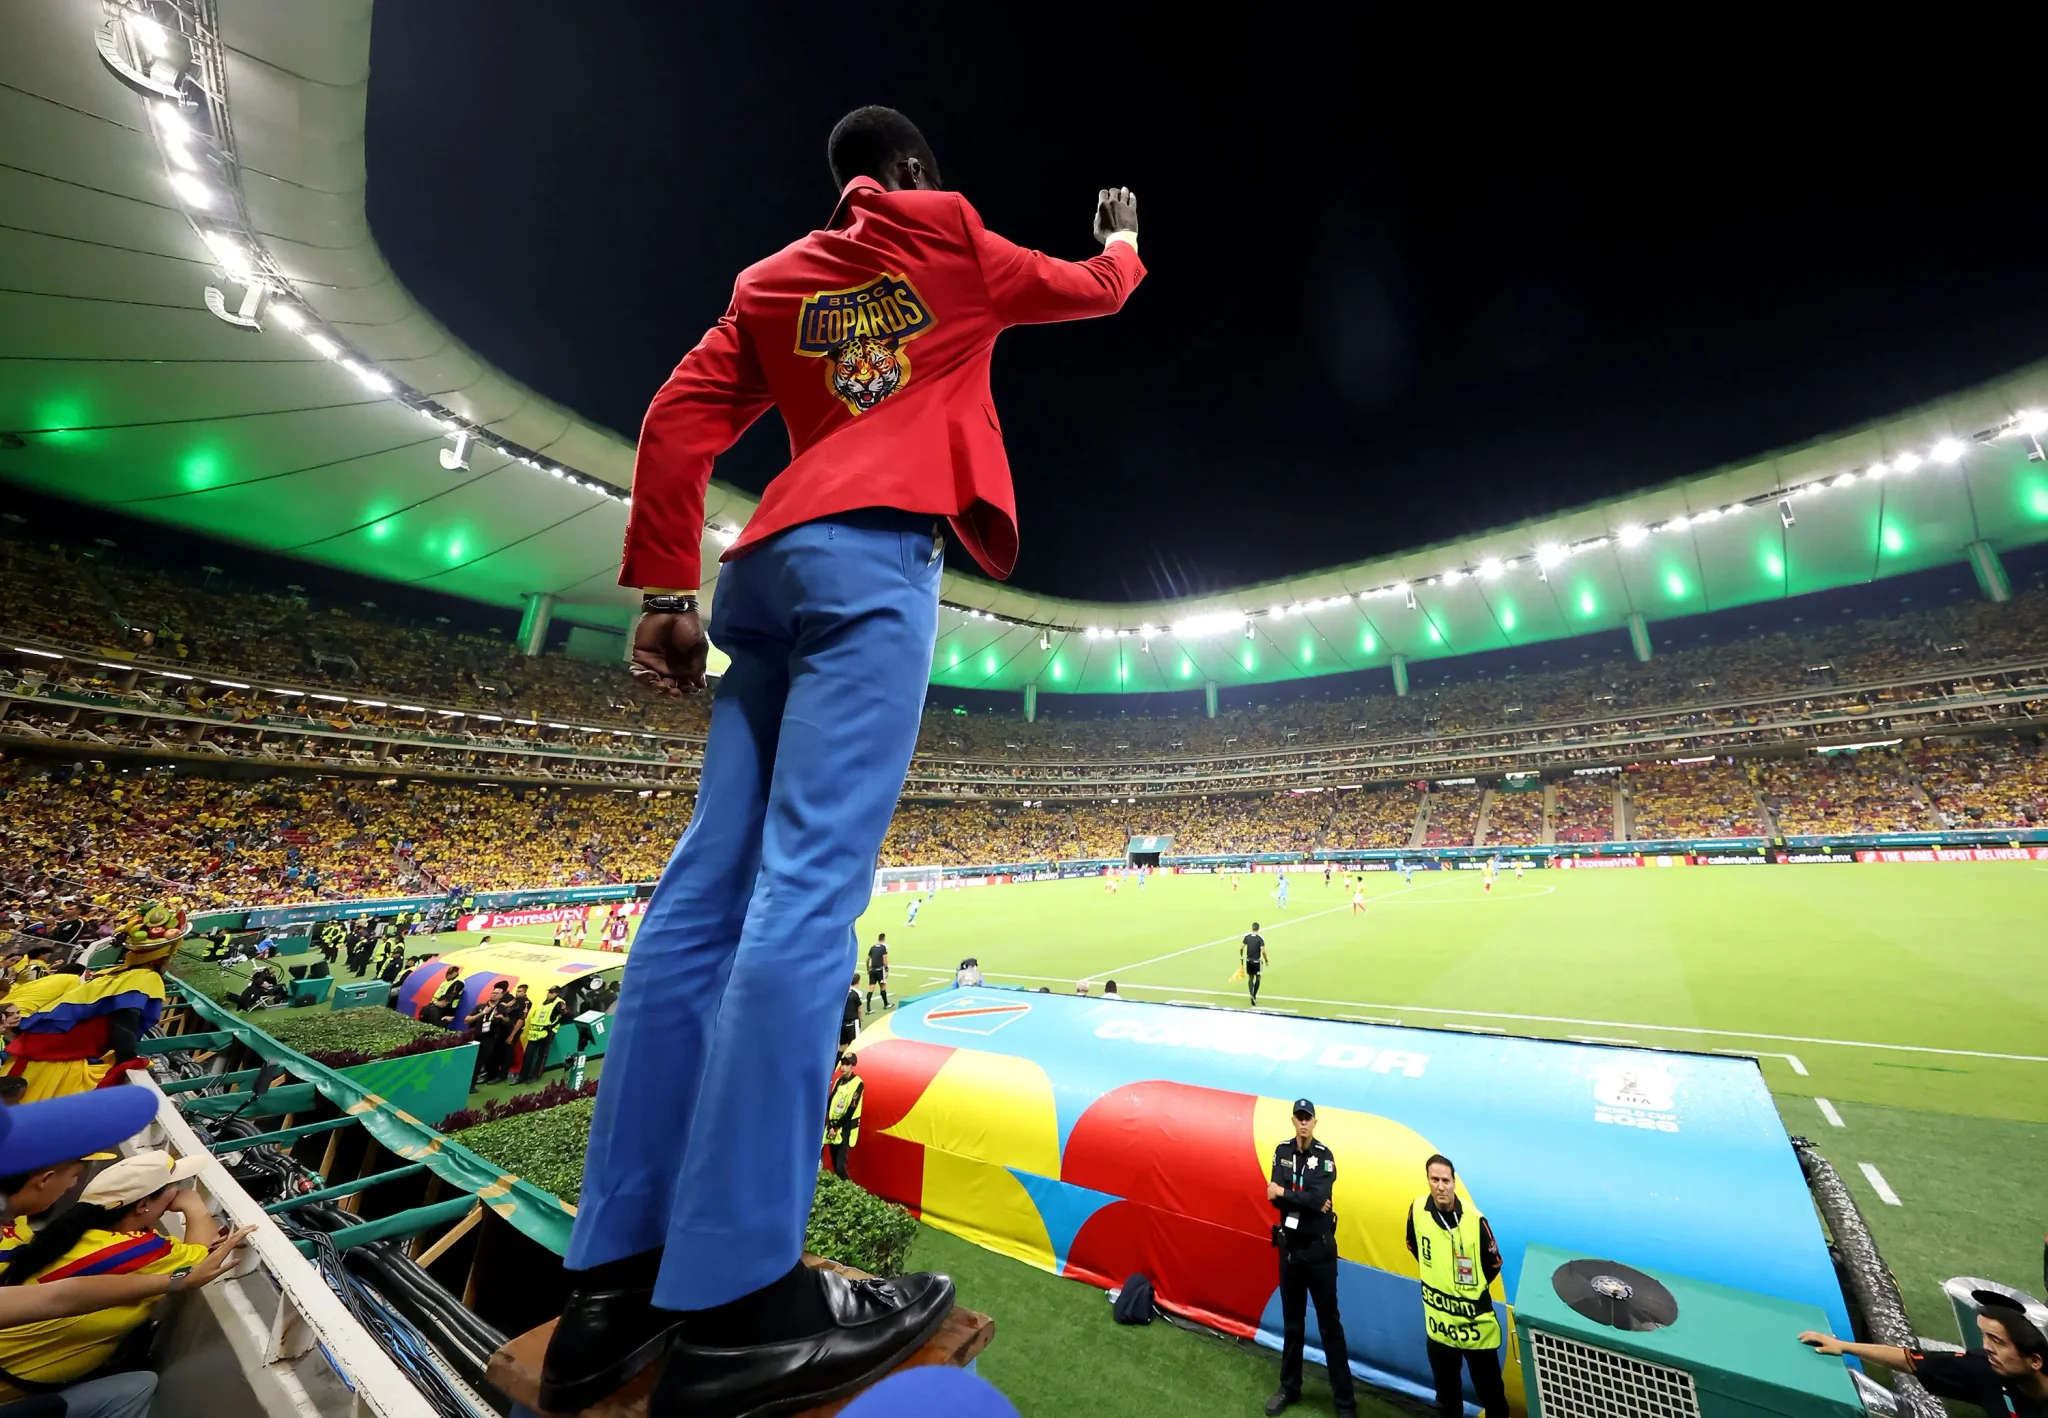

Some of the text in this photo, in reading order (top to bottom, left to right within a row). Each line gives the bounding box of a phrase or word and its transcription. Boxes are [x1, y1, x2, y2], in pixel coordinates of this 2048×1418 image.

[829, 286, 885, 307] BLOC
[805, 288, 924, 345] LEOPARDS
[1575, 857, 1637, 867] ExpressVPN
[1011, 874, 1033, 883] QATAR
[1035, 872, 1060, 881] AIRWAYS
[1316, 1043, 1430, 1078] DR
[1594, 1111, 1680, 1133] 2026
[1428, 1315, 1481, 1342] 04655
